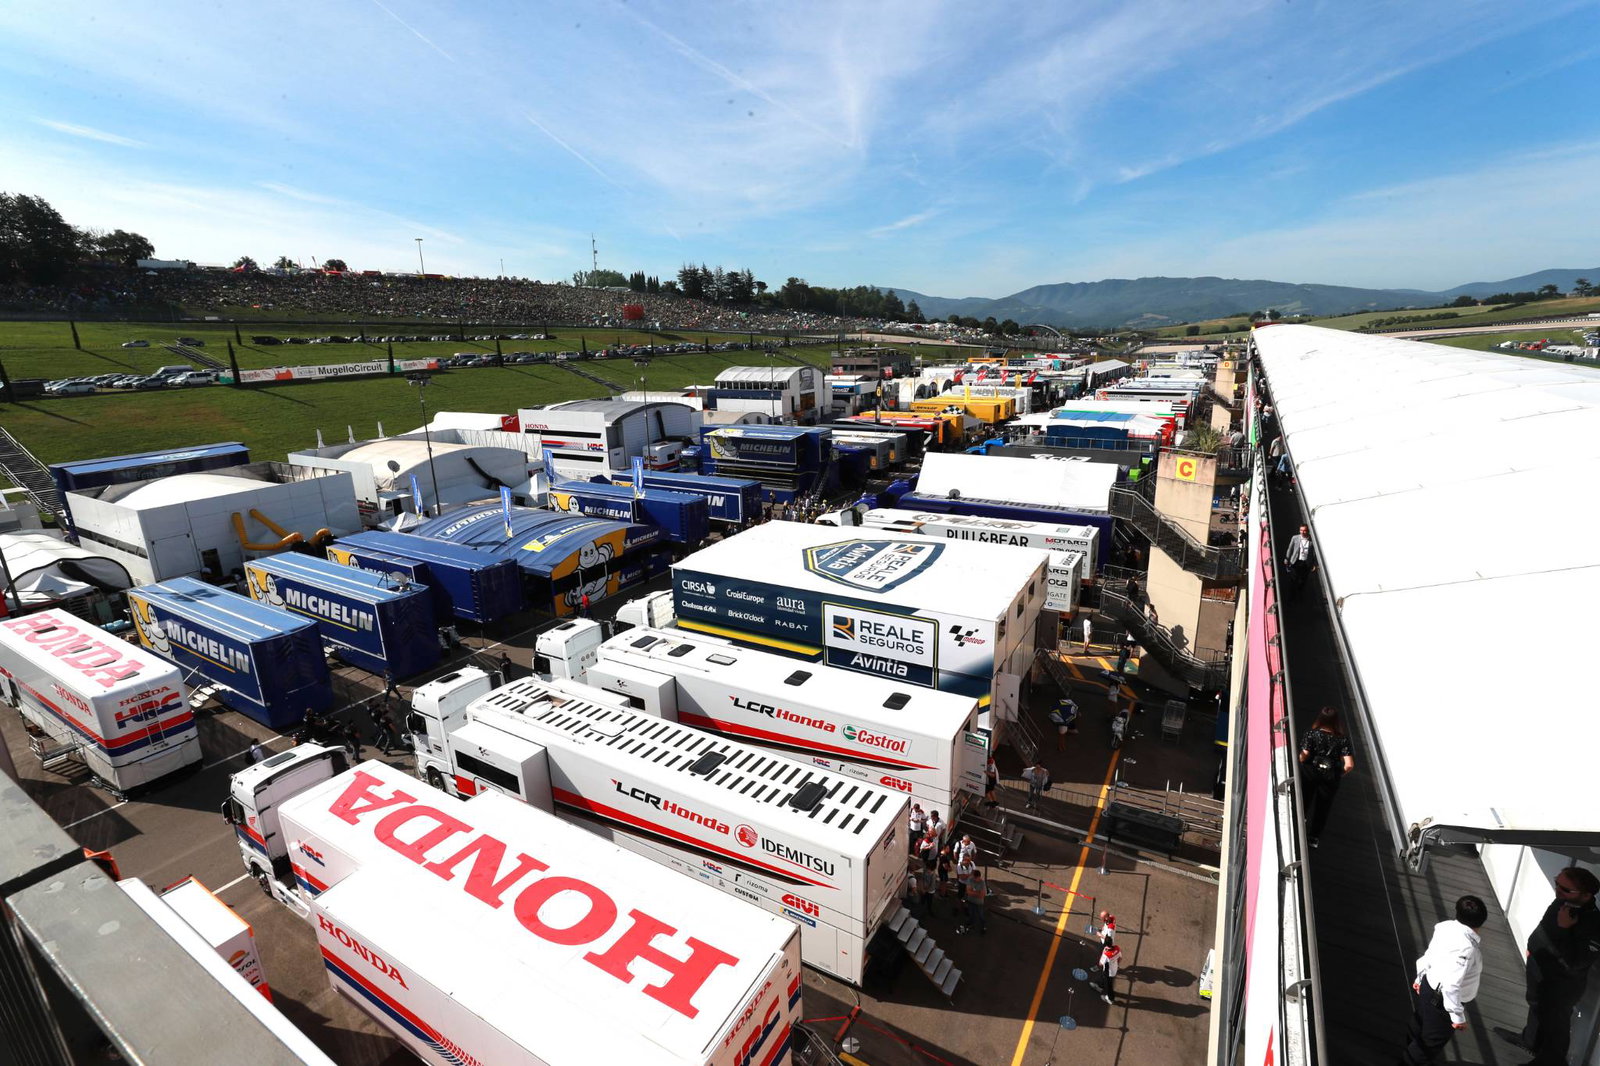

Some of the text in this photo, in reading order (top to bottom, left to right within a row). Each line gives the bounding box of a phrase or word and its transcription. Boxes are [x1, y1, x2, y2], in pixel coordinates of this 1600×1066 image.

[318, 363, 382, 376] MugelloCircuit
[740, 443, 791, 454] MICHELIN
[1180, 461, 1193, 477] C
[584, 505, 632, 519] MICHELIN
[1045, 537, 1088, 546] MOTARD
[681, 579, 707, 594] CIRSA
[726, 588, 765, 604] CroisiEurope
[286, 588, 374, 631] MICHELIN
[776, 596, 806, 610] aura
[775, 620, 808, 632] RABAT
[860, 619, 924, 644] REALE
[3, 614, 145, 687] HONDA
[166, 620, 249, 674] MICHELIN
[859, 635, 924, 655] SEGUROS
[851, 652, 908, 677] Avintia
[119, 685, 171, 707] HONDA
[114, 692, 183, 730] HRC
[733, 697, 906, 754] LCR Honda Castrol
[812, 757, 831, 768] HRC
[879, 775, 913, 792] GIVI
[616, 781, 834, 876] LCR Honda IDEMITSU
[328, 770, 740, 1019] HONDA
[702, 860, 723, 874] HRC
[746, 880, 769, 893] rizoma
[781, 893, 820, 918] GIVI
[734, 887, 759, 902] CUSTOM
[316, 913, 410, 991] HONDA
[724, 981, 772, 1049] HONDA
